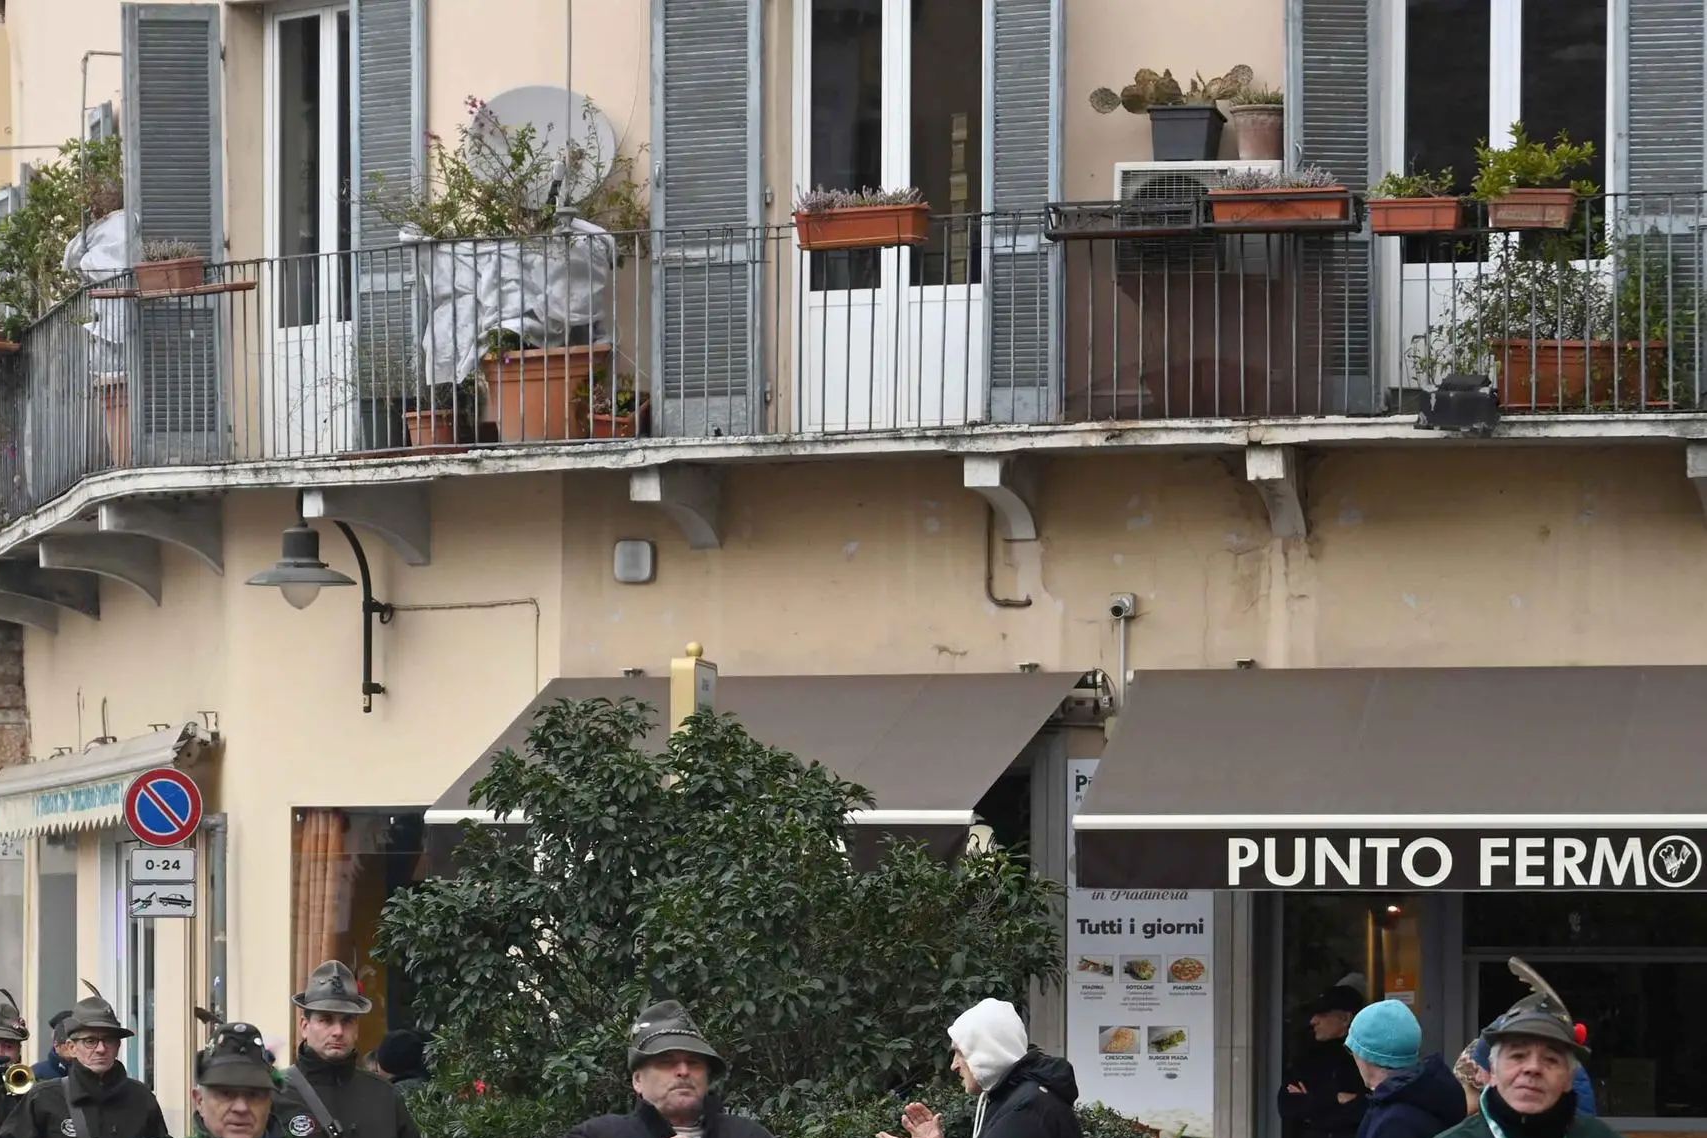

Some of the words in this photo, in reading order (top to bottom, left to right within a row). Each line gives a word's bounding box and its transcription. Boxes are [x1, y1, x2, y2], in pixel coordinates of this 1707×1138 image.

[145, 859, 181, 871] 0-24
[1228, 837, 1453, 887] PUNTO
[1076, 918, 1122, 935] Tutti
[1129, 918, 1135, 935] i
[1142, 918, 1204, 939] giorni
